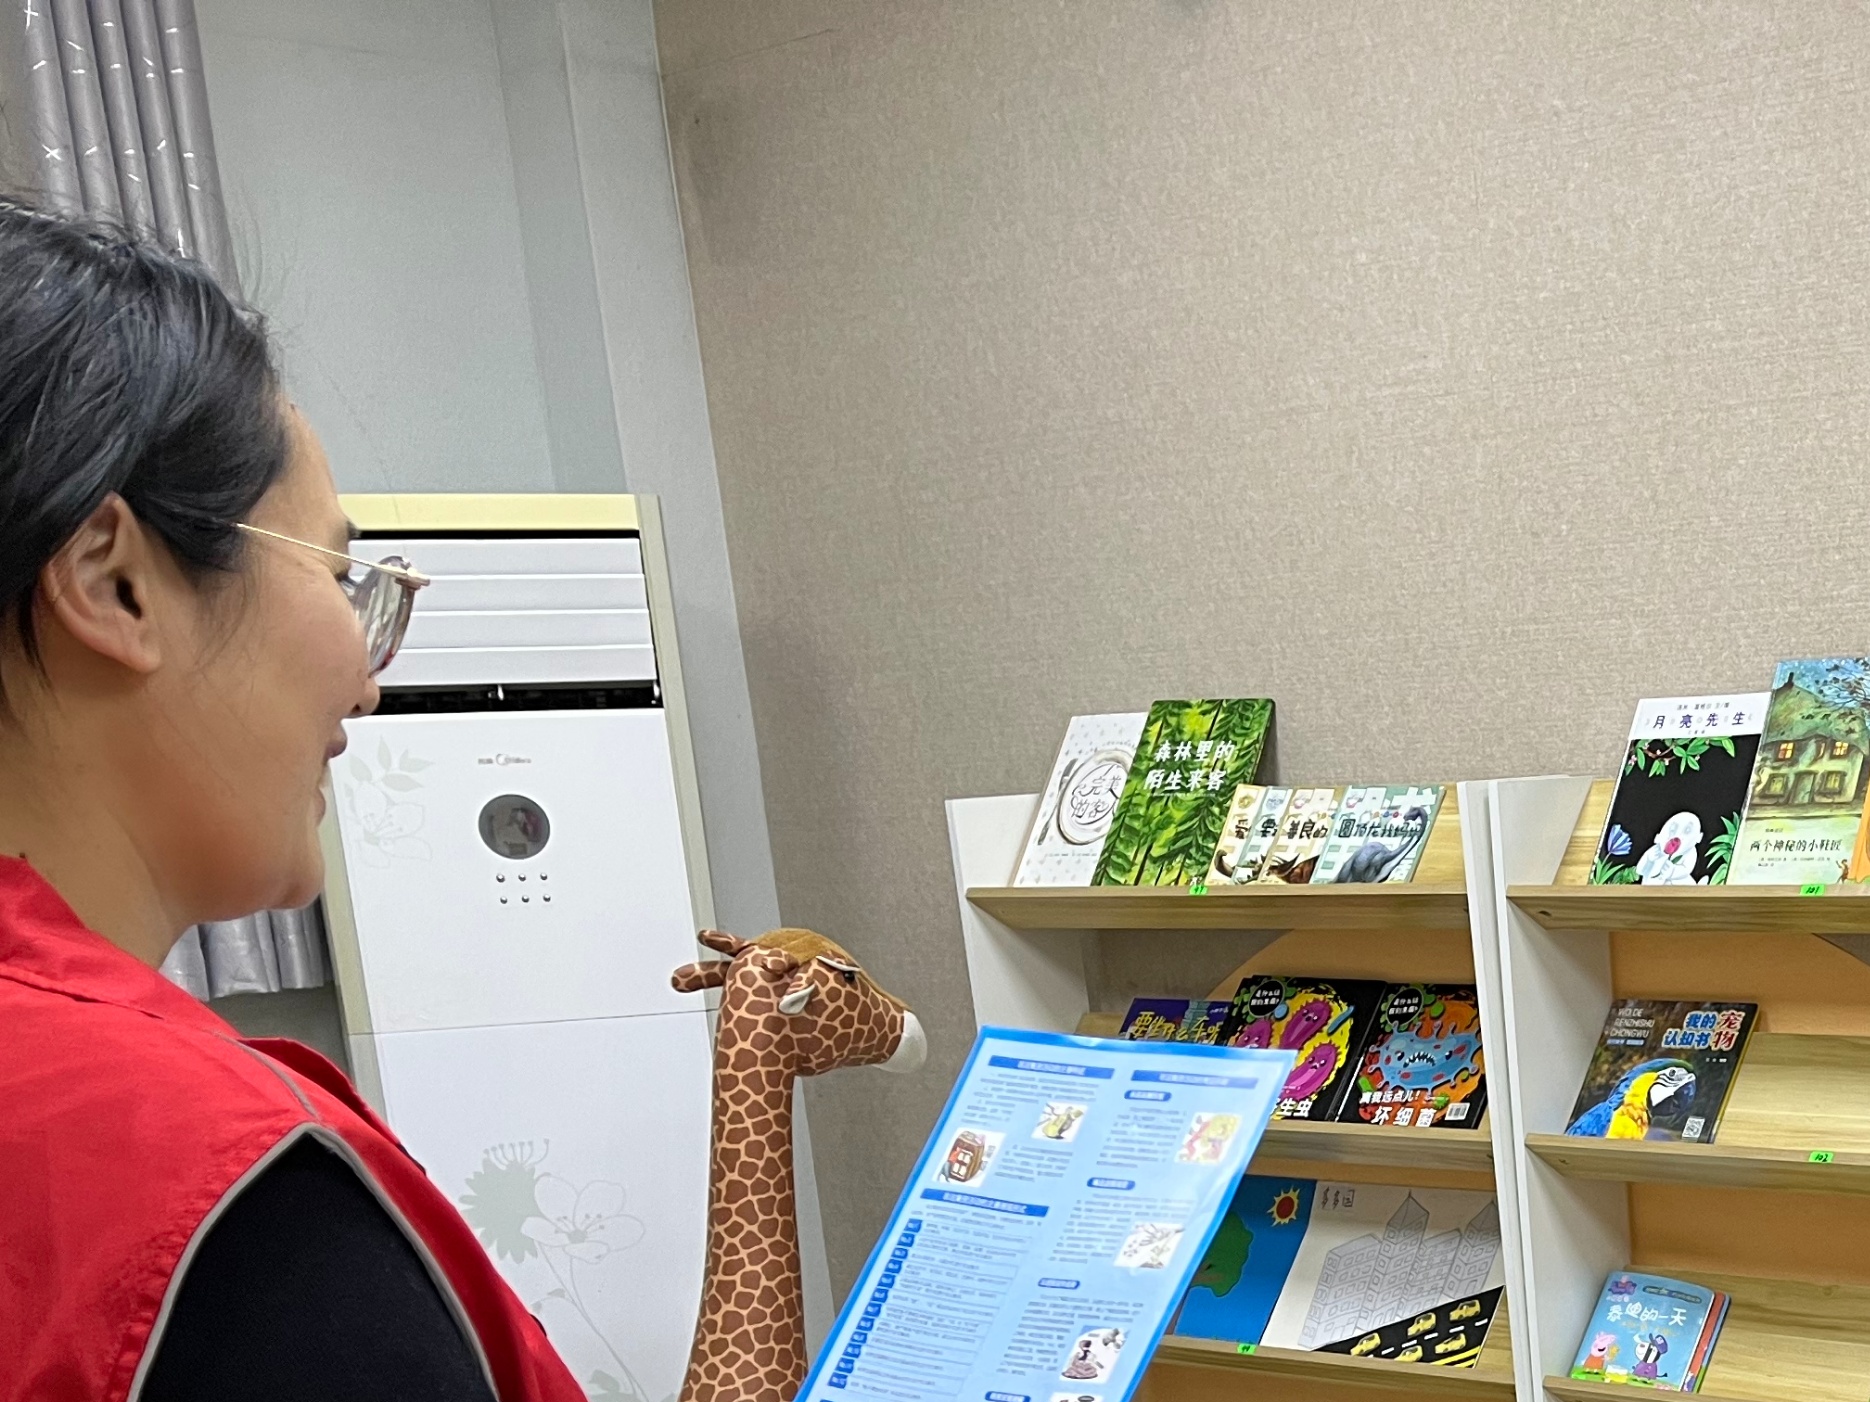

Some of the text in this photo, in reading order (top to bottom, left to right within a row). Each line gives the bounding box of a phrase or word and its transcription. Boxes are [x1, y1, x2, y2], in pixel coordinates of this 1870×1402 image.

[1653, 712, 1745, 729] 月亮先生
[1154, 740, 1235, 762] 森林里的
[1144, 769, 1226, 790] 陌生来客
[1271, 1097, 1312, 1118] 生虫
[1371, 1106, 1437, 1128] 坏细菌
